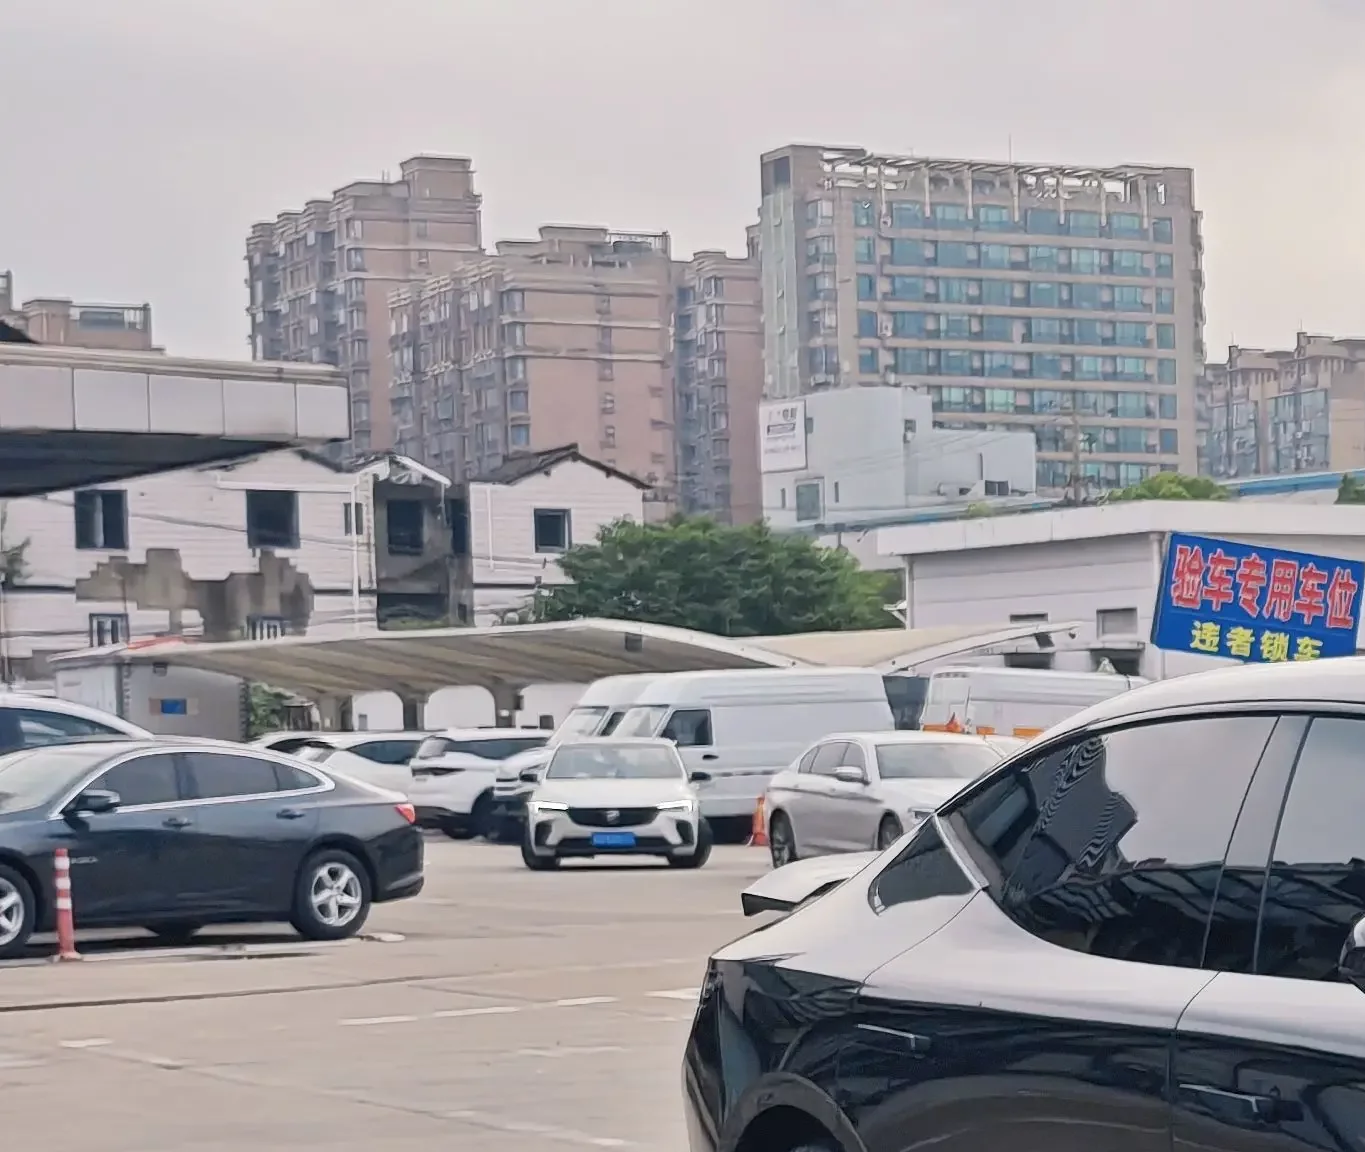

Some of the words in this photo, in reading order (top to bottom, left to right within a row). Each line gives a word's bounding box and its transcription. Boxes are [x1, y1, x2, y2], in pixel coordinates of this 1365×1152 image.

[1172, 545, 1357, 628] 验车专用车位
[1190, 620, 1323, 663] 违者锁车
